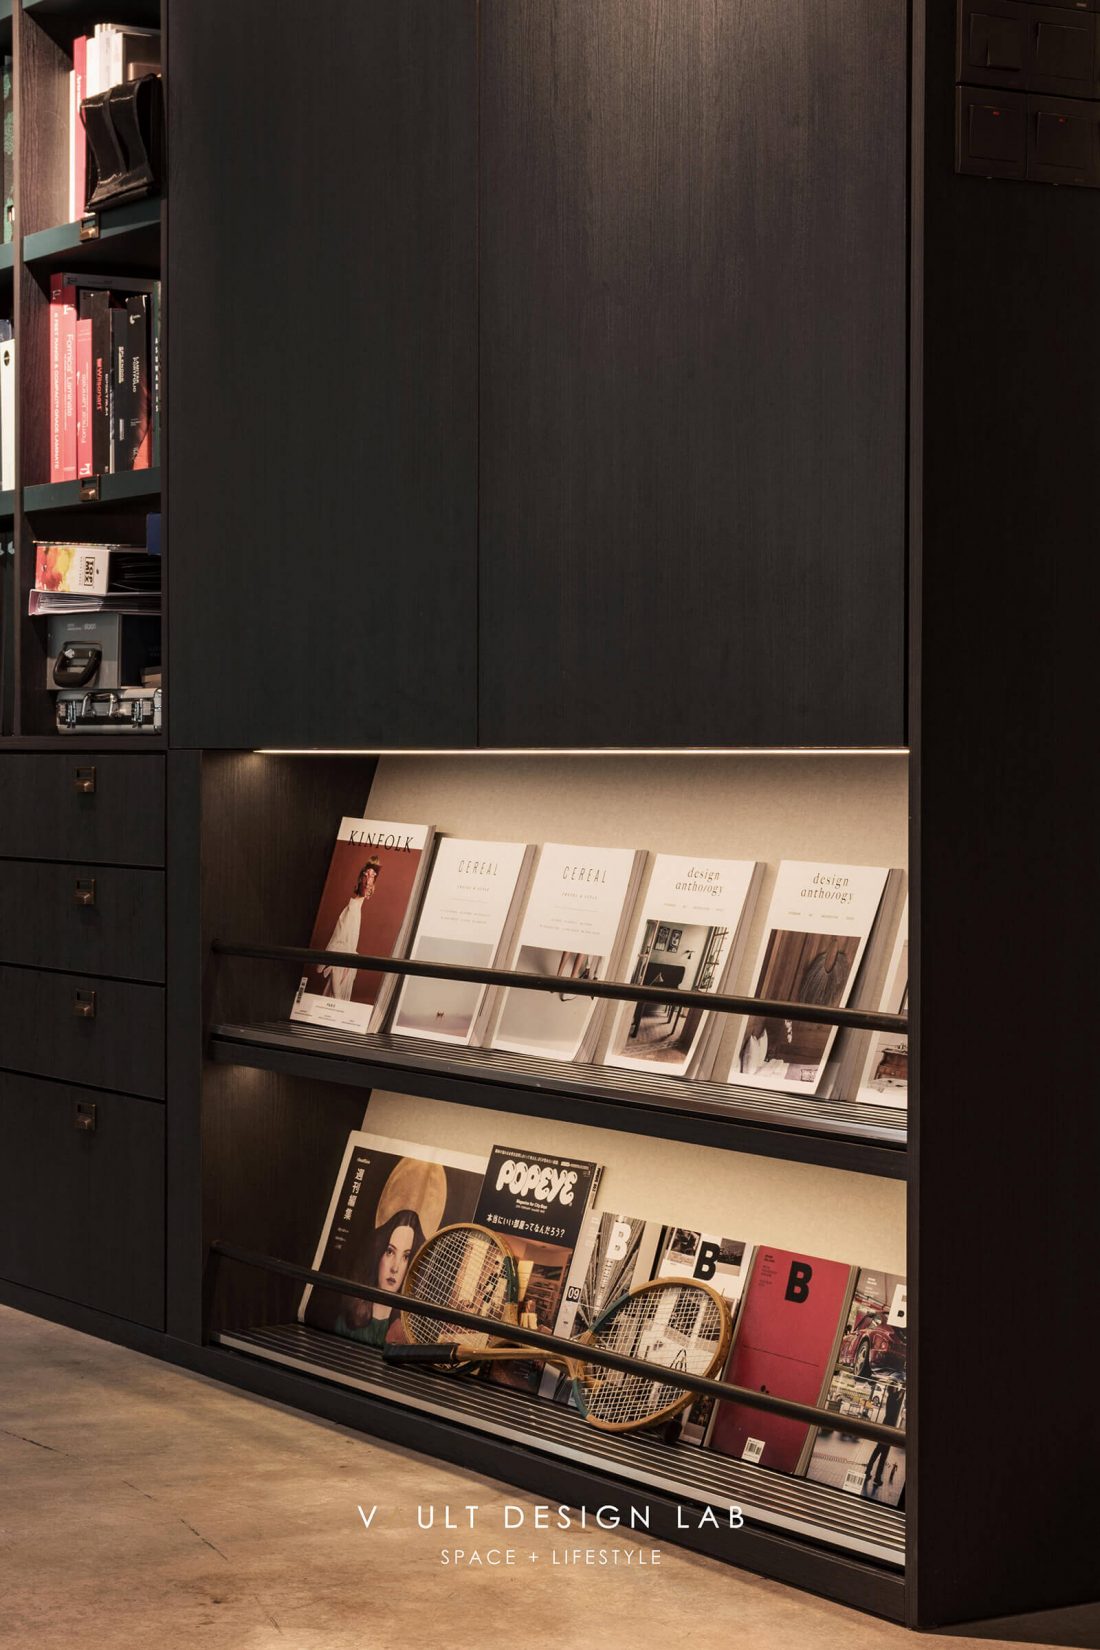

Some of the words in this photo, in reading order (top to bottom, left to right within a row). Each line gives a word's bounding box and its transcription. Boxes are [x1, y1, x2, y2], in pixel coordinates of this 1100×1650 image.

[348, 830, 413, 853] KINFOLK
[458, 860, 498, 876] CEREAL
[562, 865, 608, 884] CEREAL
[687, 867, 720, 882] design
[675, 881, 723, 897] anthology
[812, 872, 849, 889] design
[800, 887, 854, 904] anthology
[495, 1159, 578, 1205] POPEYE
[605, 1222, 631, 1260] B
[693, 1241, 720, 1281] B
[785, 1261, 812, 1304] B
[568, 1287, 580, 1300] 09
